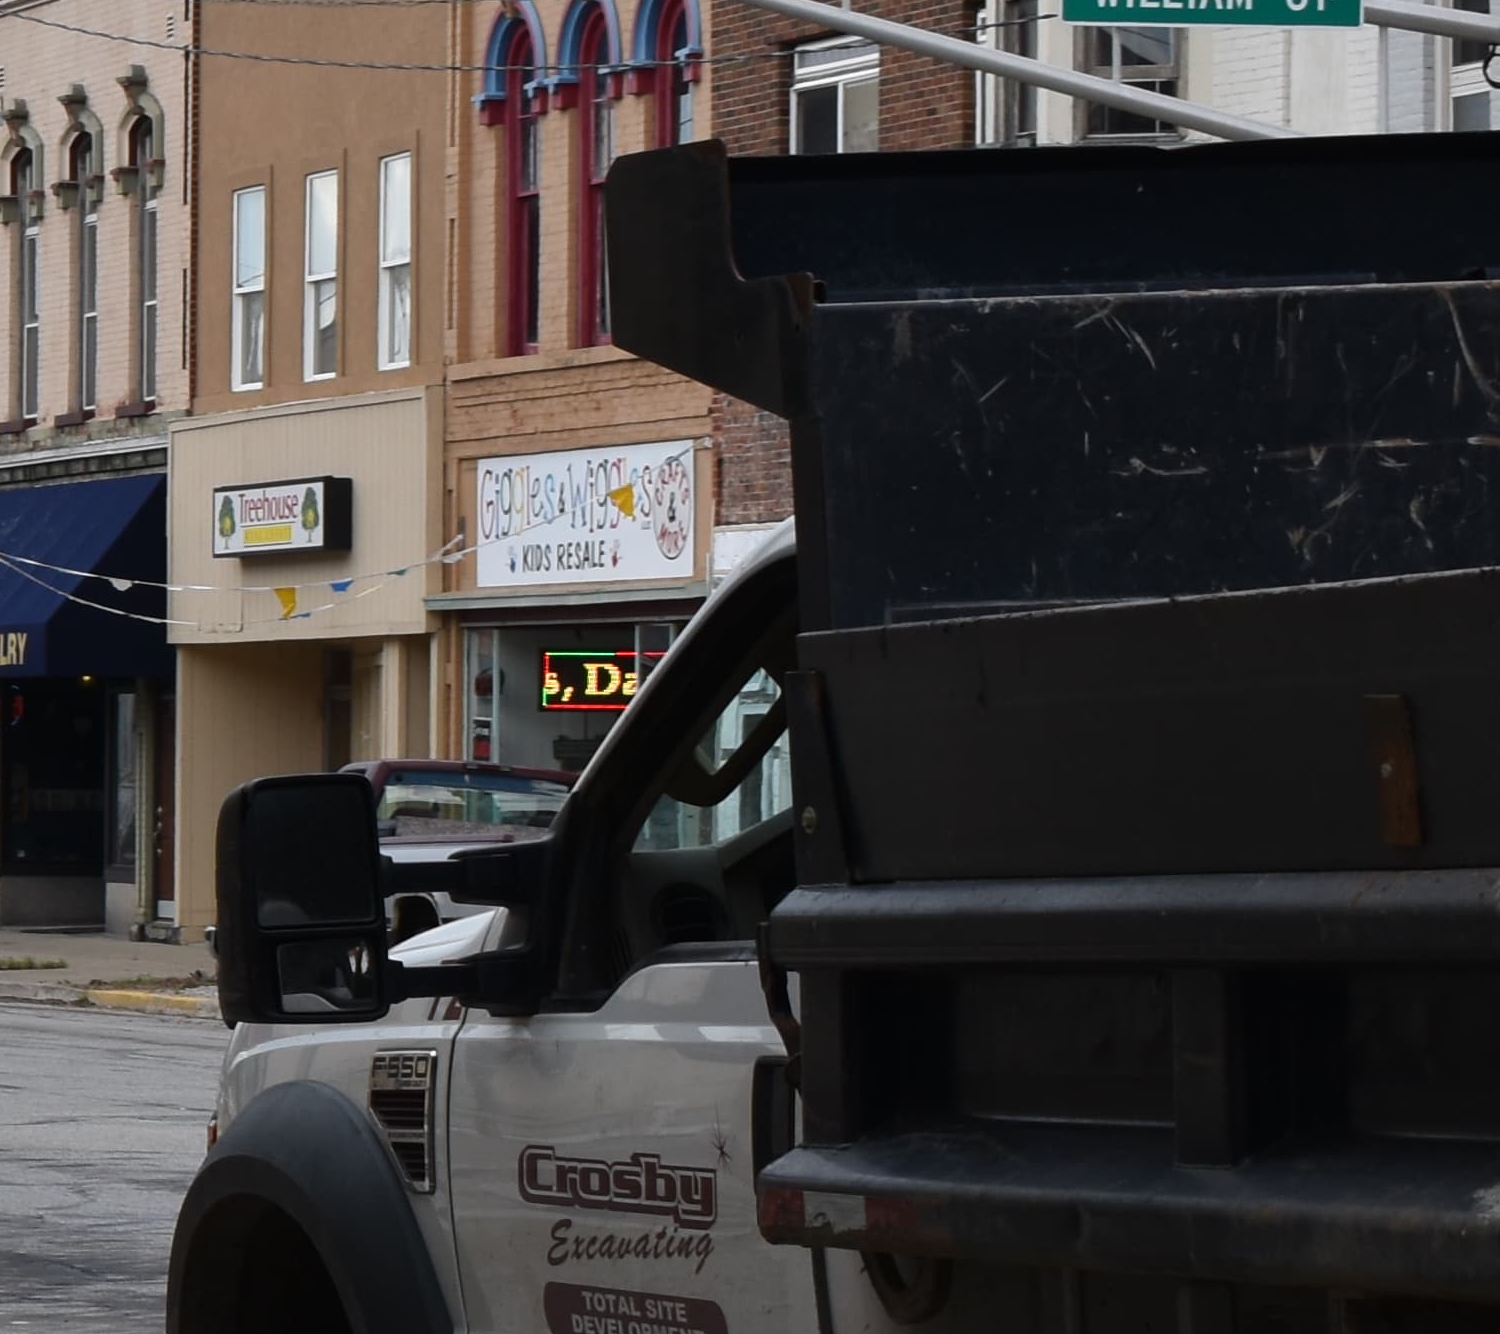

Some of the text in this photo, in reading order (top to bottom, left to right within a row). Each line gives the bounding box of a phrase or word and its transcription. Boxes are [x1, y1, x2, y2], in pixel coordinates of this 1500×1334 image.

[238, 489, 299, 524] Treehouse
[480, 465, 556, 540] Giggles
[522, 540, 606, 572] KIDS RESALE
[372, 1056, 429, 1079] F550
[518, 1144, 718, 1229] Crosby
[547, 1218, 715, 1274] Excavating
[581, 1290, 688, 1323] TOTAL SITE
